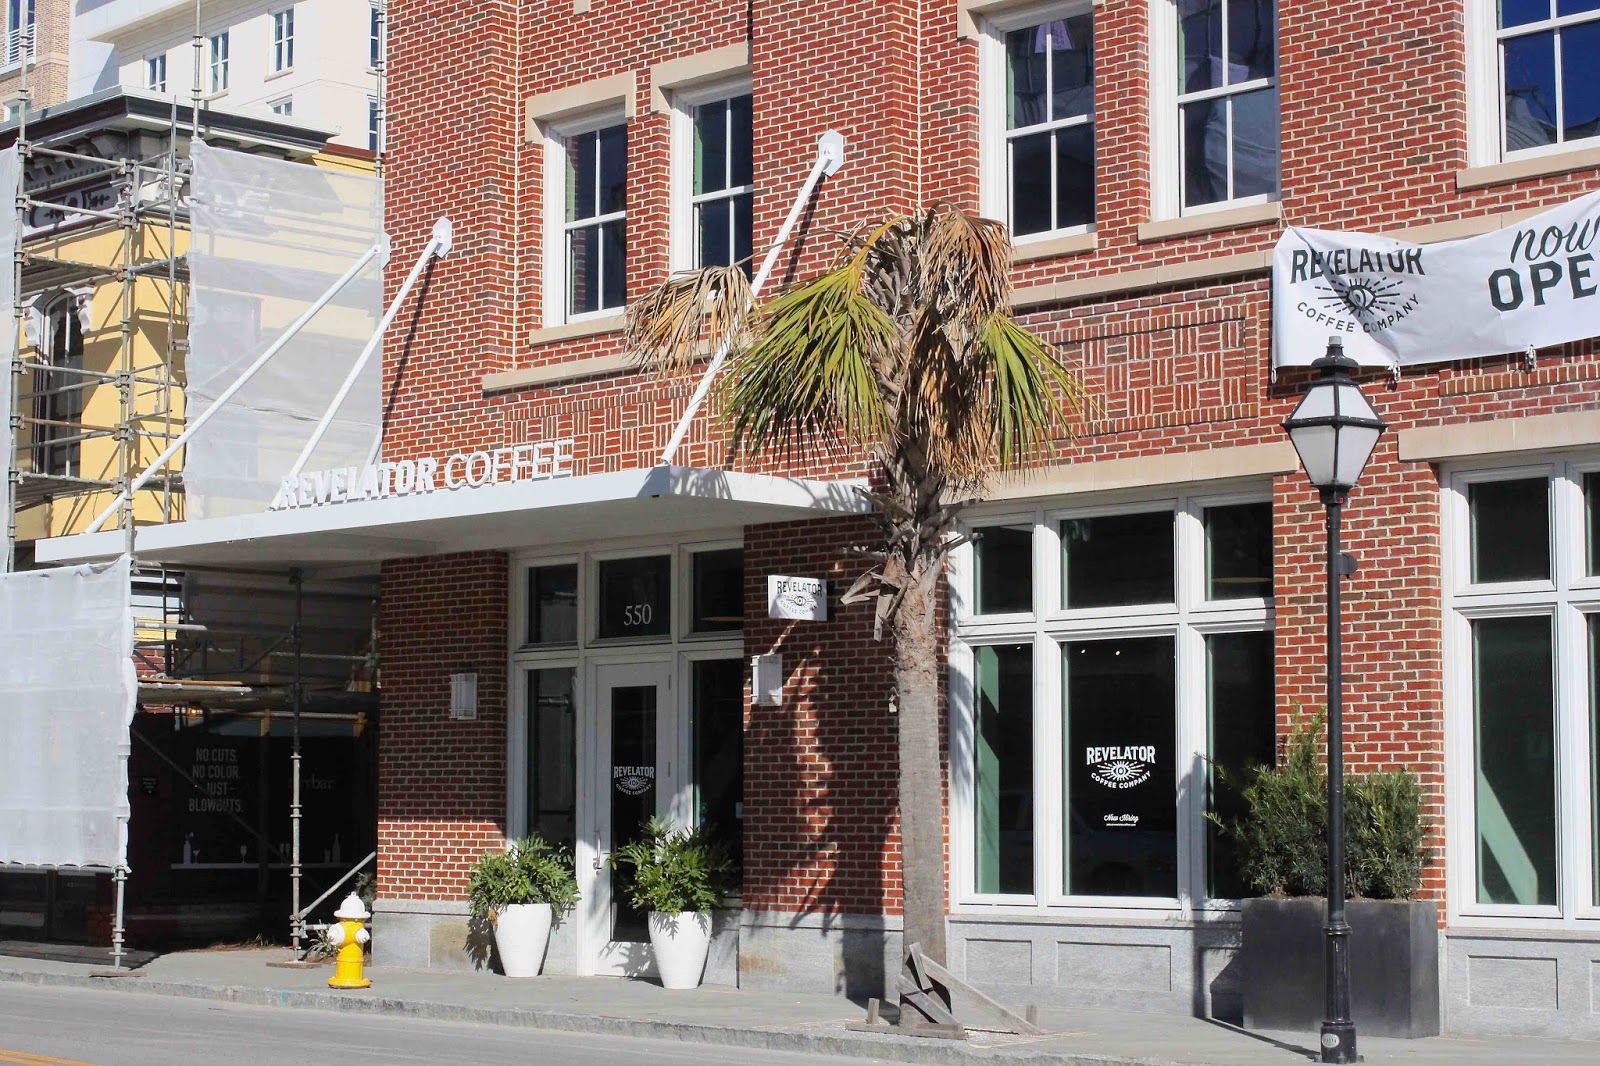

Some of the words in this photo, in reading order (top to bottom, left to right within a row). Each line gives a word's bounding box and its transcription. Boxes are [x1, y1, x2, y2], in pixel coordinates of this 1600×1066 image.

[1510, 217, 1600, 264] now
[1290, 247, 1425, 284] REVELATOR
[1487, 250, 1600, 312] OPE
[1297, 301, 1355, 333] COFFEE
[1362, 293, 1419, 334] COMPANY
[280, 456, 437, 509] REVELATOR
[444, 439, 574, 490] COFFEE
[776, 580, 823, 597] REVELATOR
[623, 603, 652, 626] 550
[196, 747, 209, 761] NO
[1086, 745, 1156, 765] REVELATOR
[192, 764, 205, 778] NO
[613, 766, 654, 778] REVELATOR
[1091, 772, 1117, 788] COFFEE
[1119, 770, 1151, 789] COMPANY
